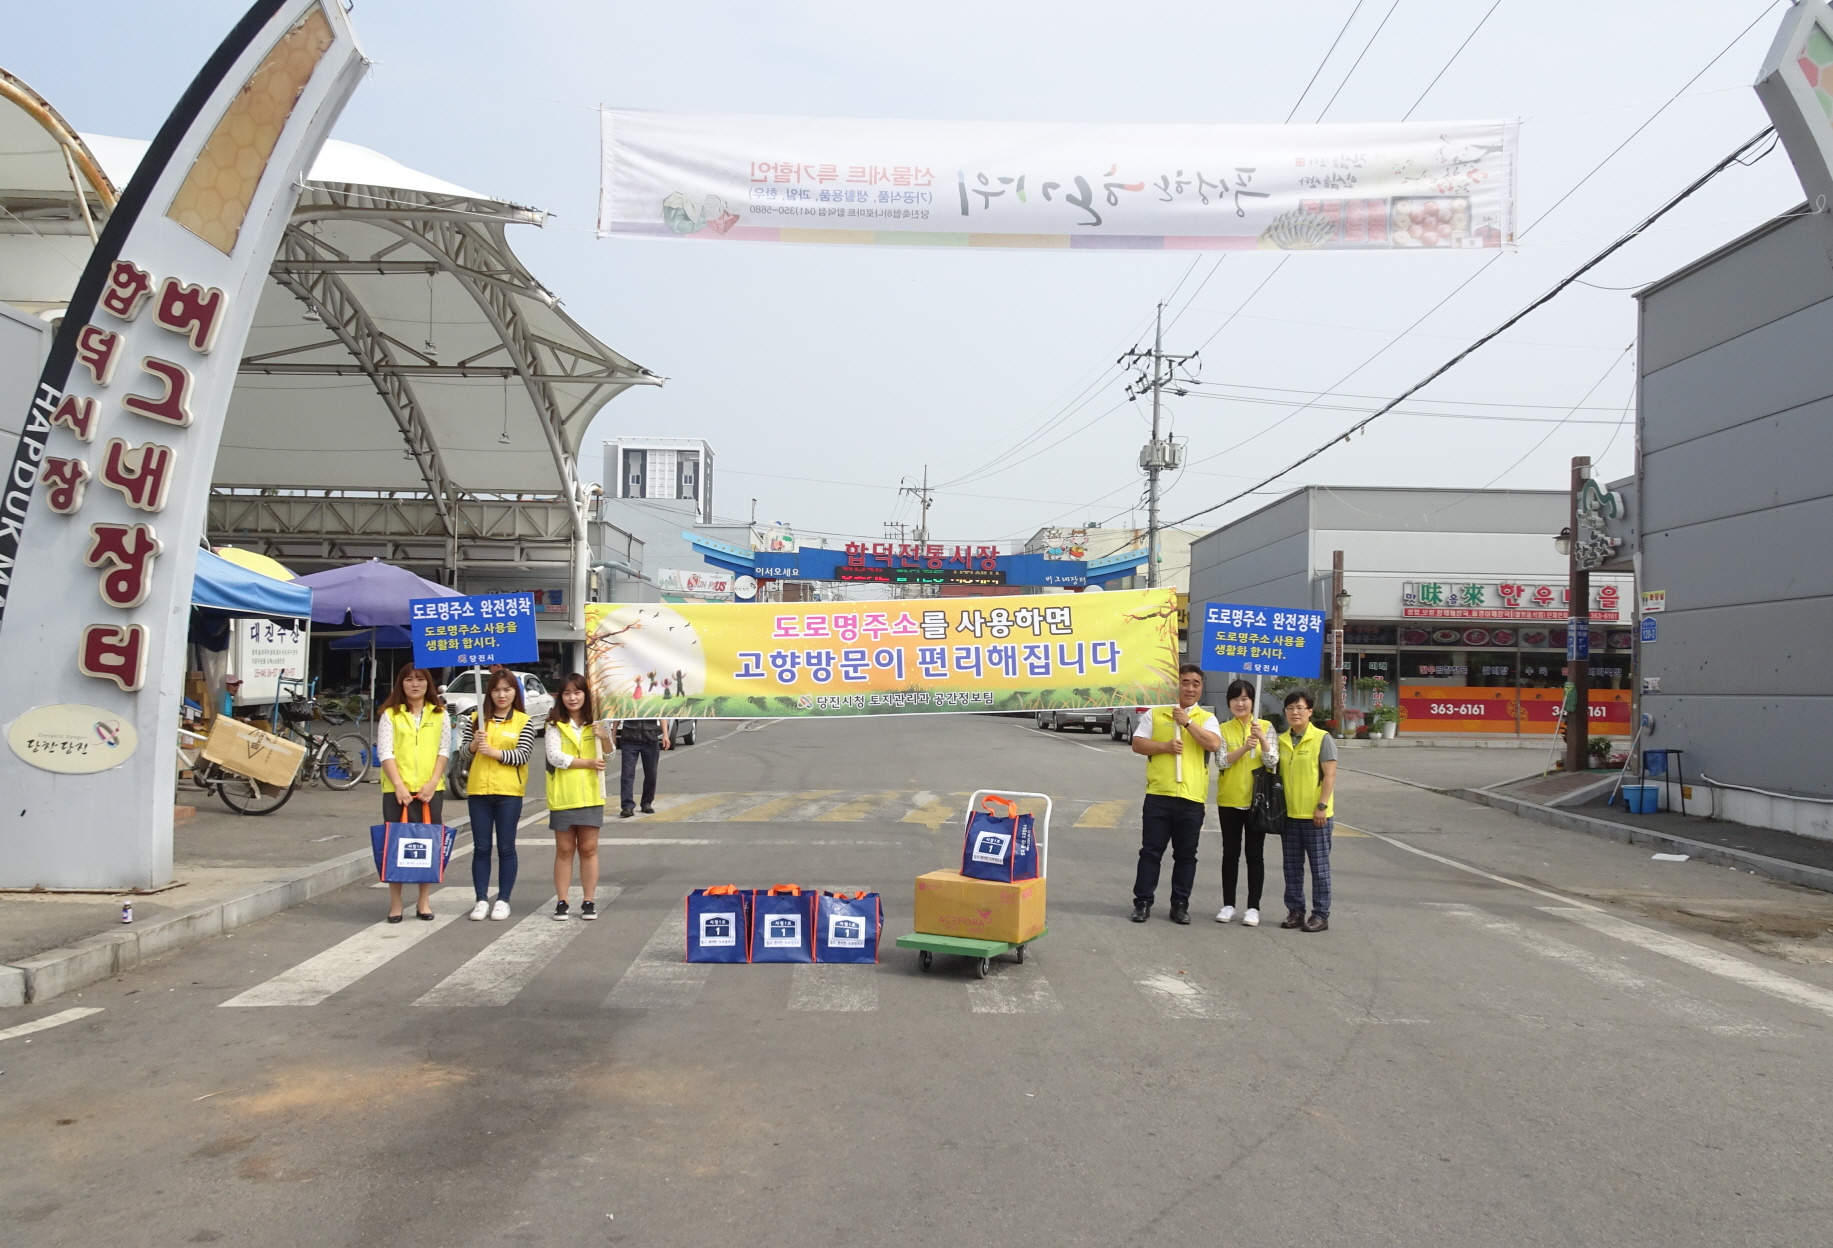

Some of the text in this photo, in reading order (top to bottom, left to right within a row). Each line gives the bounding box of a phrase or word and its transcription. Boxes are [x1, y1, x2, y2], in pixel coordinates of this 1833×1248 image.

[39, 259, 156, 515] 합덕시장
[0, 382, 62, 546] HAPDUK
[78, 276, 229, 692] 버그내장터
[845, 541, 1000, 571] 합덕전통시장
[1498, 582, 1620, 610] 한우을
[413, 602, 475, 620] 도로명주소
[480, 597, 532, 618] 완전정착
[424, 621, 518, 636] 도로명주소 사용을
[772, 606, 1073, 641] 도로명주소를 사용하면
[1206, 608, 1267, 628] 도로명주소
[1272, 612, 1322, 633] 완전정착
[250, 622, 299, 644] 대진수산
[1215, 631, 1306, 648] 도로명주소 사용을
[425, 636, 500, 651] 생활화 합시다.
[1214, 644, 1286, 660] 생활화 합시다.
[469, 654, 495, 663] 당진시
[732, 639, 1122, 684] 고향방문이 편리해집니다
[1254, 663, 1279, 673] 당진시
[816, 691, 995, 710] 당진시청 토지관리과 공간정보팀
[1430, 704, 1485, 715] 363-6161
[938, 915, 985, 927] ACEPORA
[716, 927, 720, 935] 1
[781, 928, 786, 936] 1
[845, 929, 850, 937] 1
